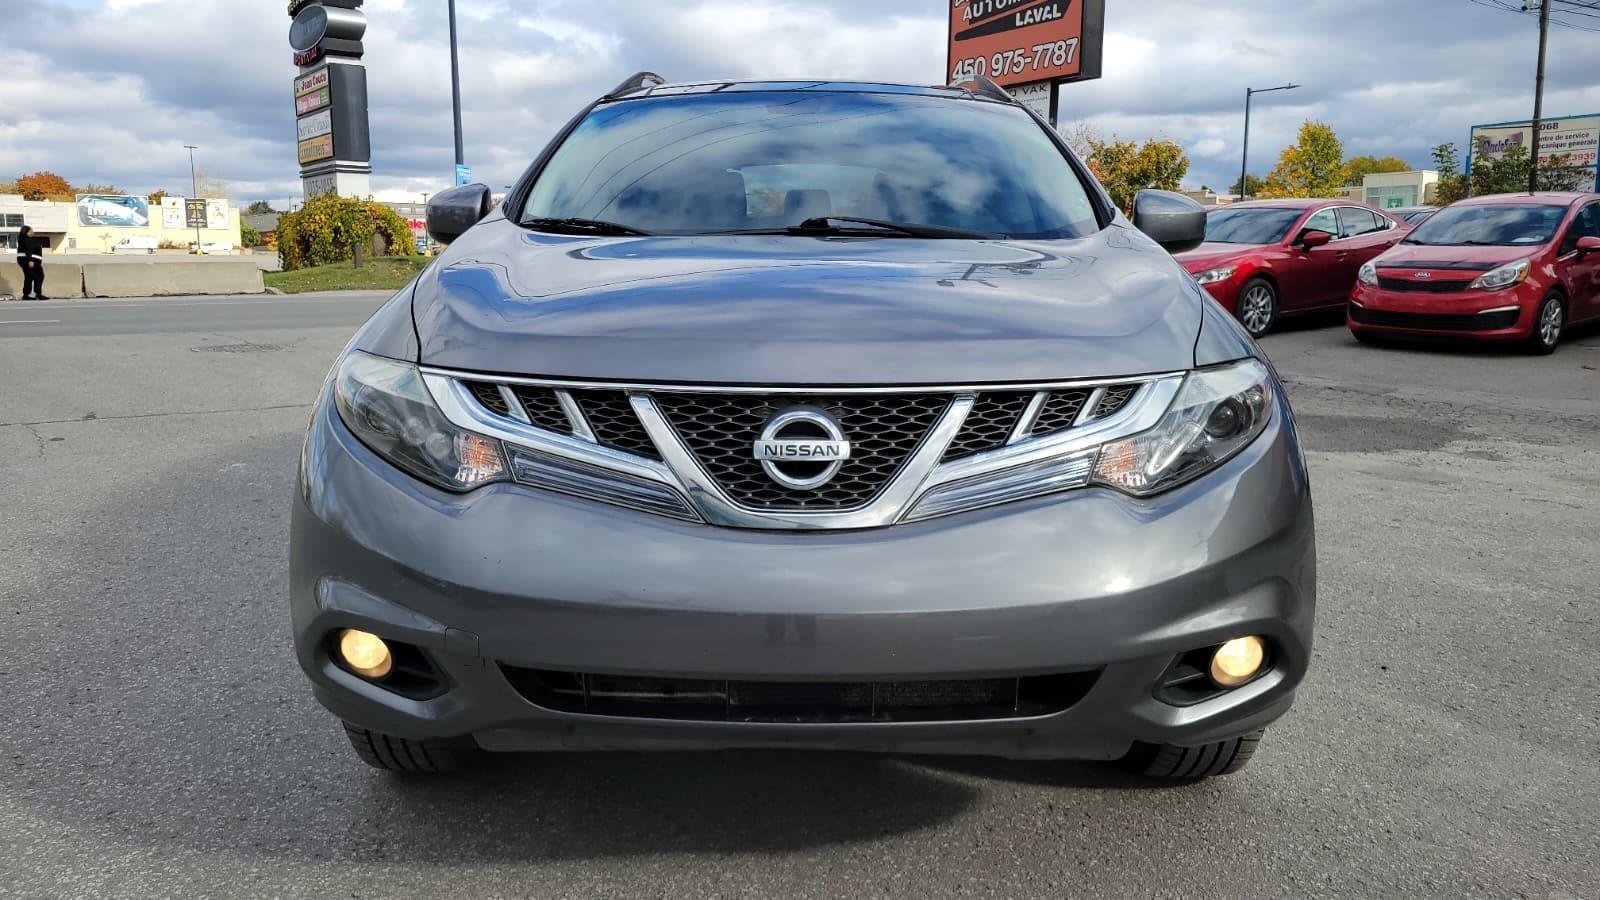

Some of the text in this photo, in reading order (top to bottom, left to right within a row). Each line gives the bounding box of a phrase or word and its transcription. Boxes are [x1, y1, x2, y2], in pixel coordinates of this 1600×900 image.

[1015, 3, 1062, 27] LAVAL
[952, 37, 1079, 80] 450 975-7787
[764, 444, 840, 457] NISSAN
